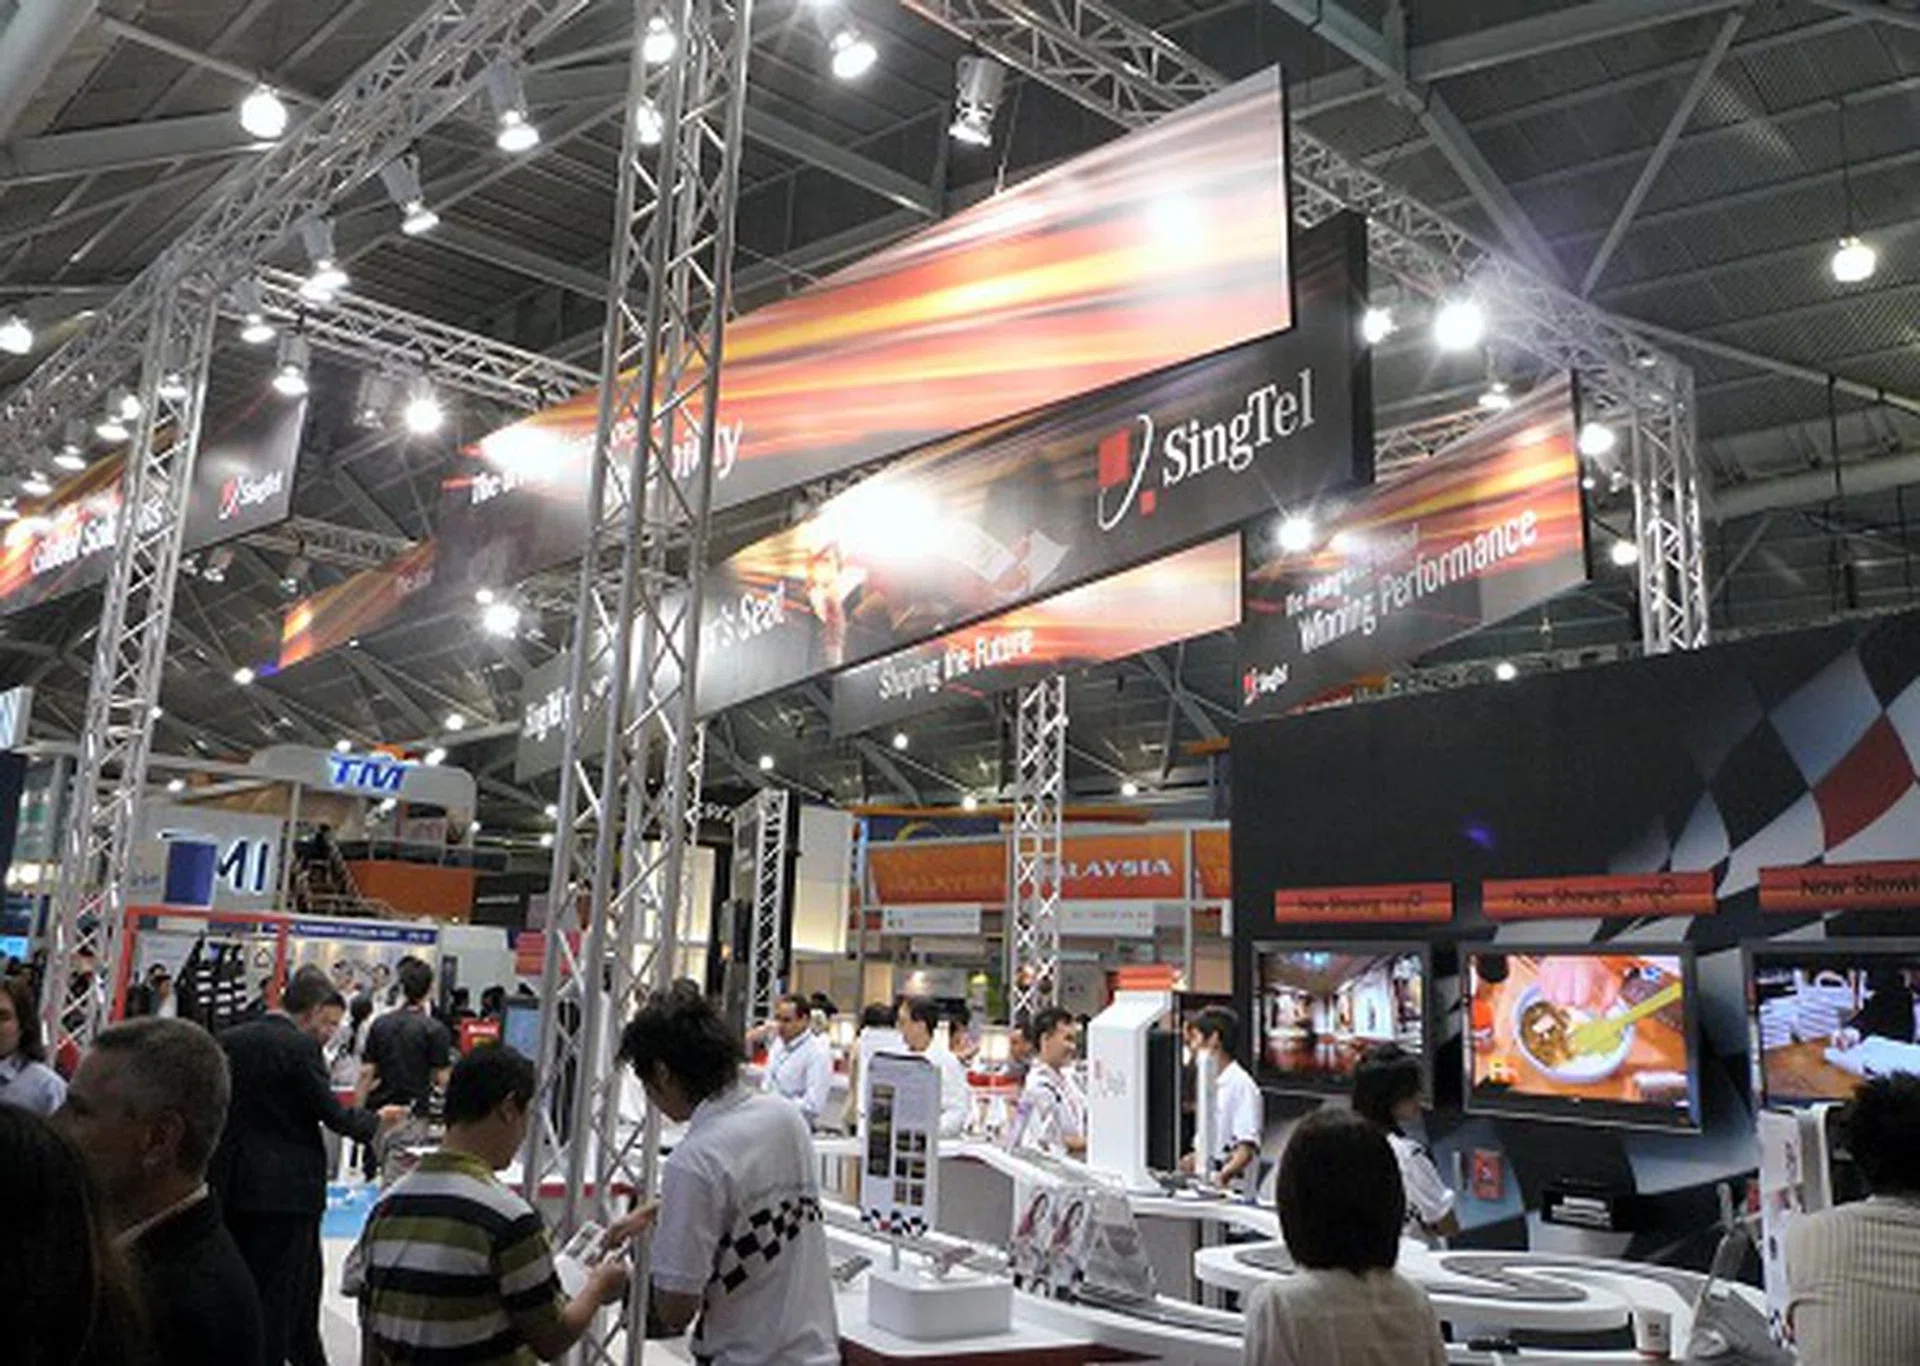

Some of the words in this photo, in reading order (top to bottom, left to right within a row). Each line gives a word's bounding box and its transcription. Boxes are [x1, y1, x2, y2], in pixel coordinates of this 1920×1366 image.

[1163, 368, 1315, 487] SingTel
[1298, 594, 1378, 653] Winning
[1380, 510, 1538, 615] Performance
[330, 754, 405, 790] TM
